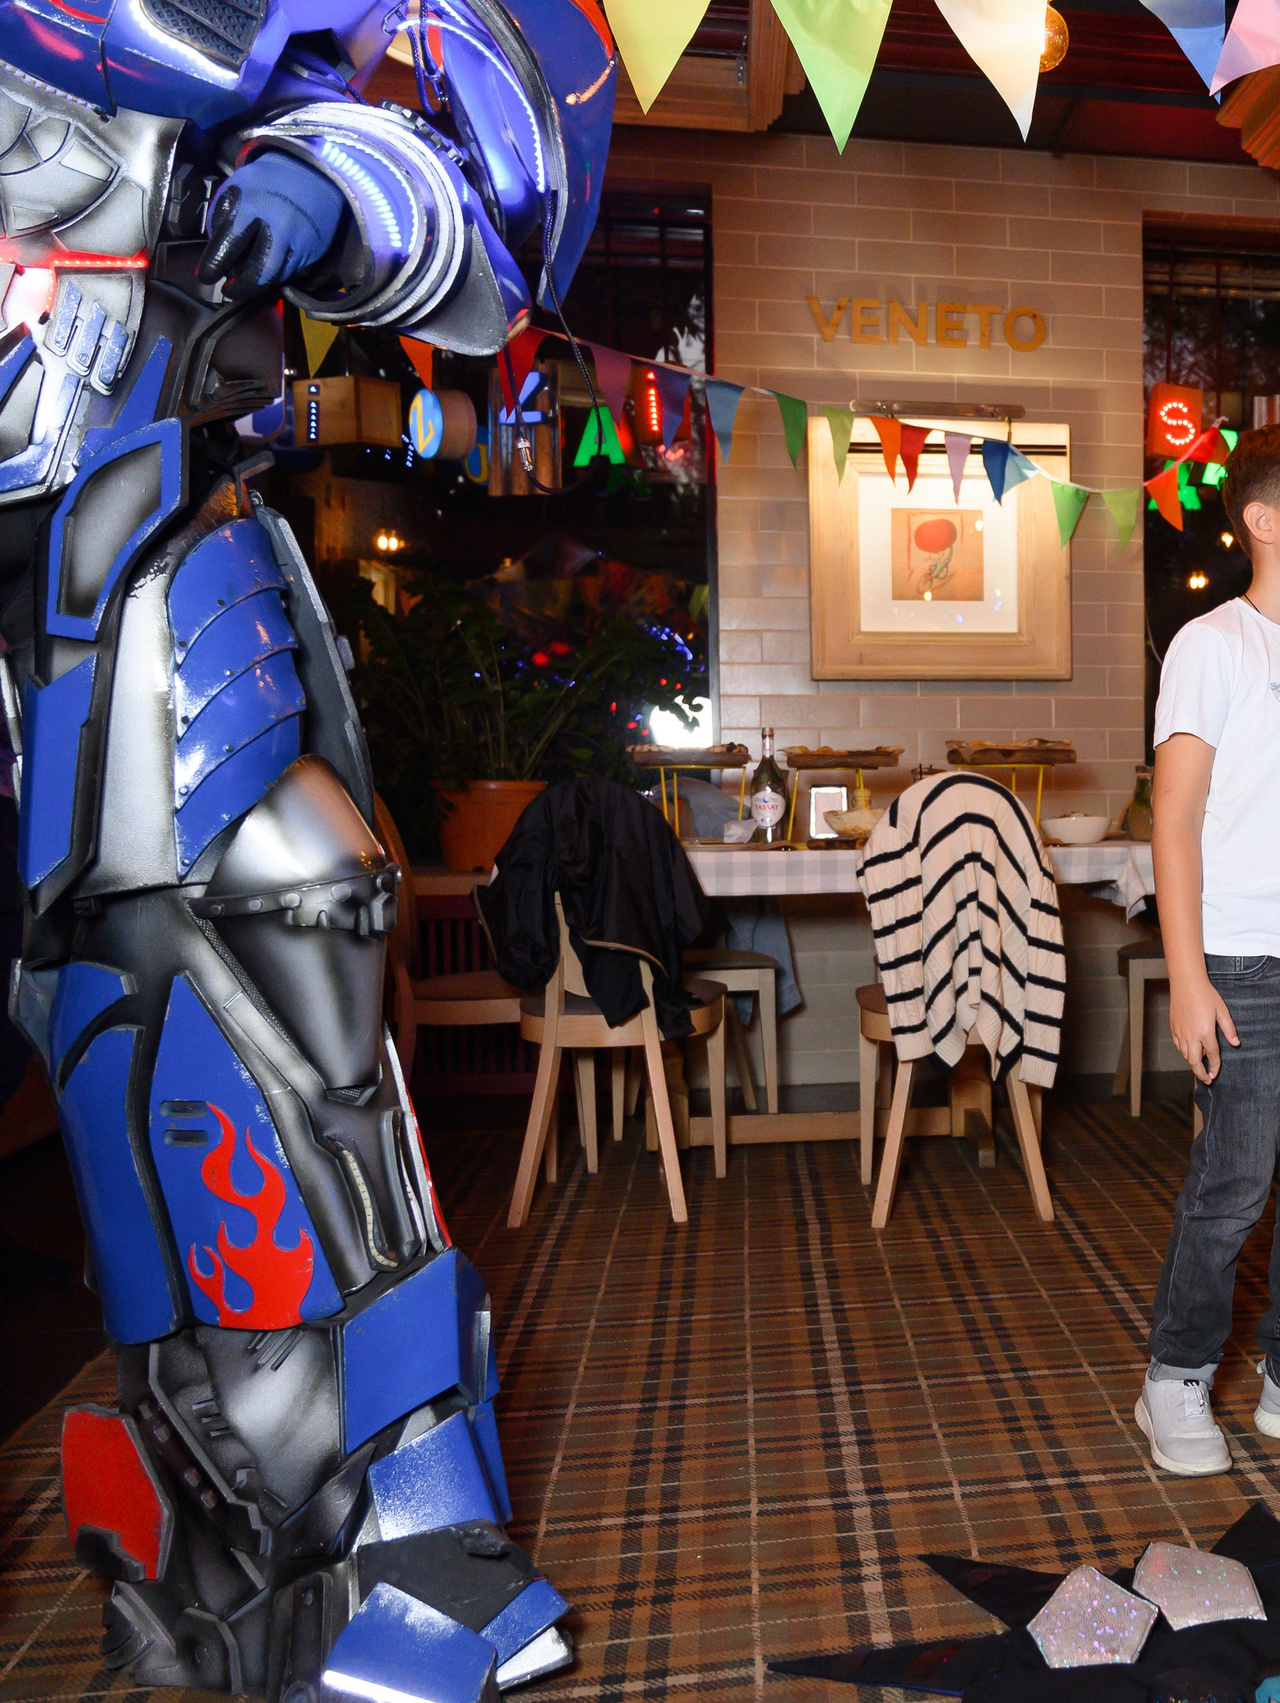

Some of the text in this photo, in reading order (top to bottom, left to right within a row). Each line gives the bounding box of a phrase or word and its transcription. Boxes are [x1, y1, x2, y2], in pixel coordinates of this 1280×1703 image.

[806, 296, 1047, 352] VENETO
[573, 406, 626, 467] A
[1159, 402, 1196, 446] S
